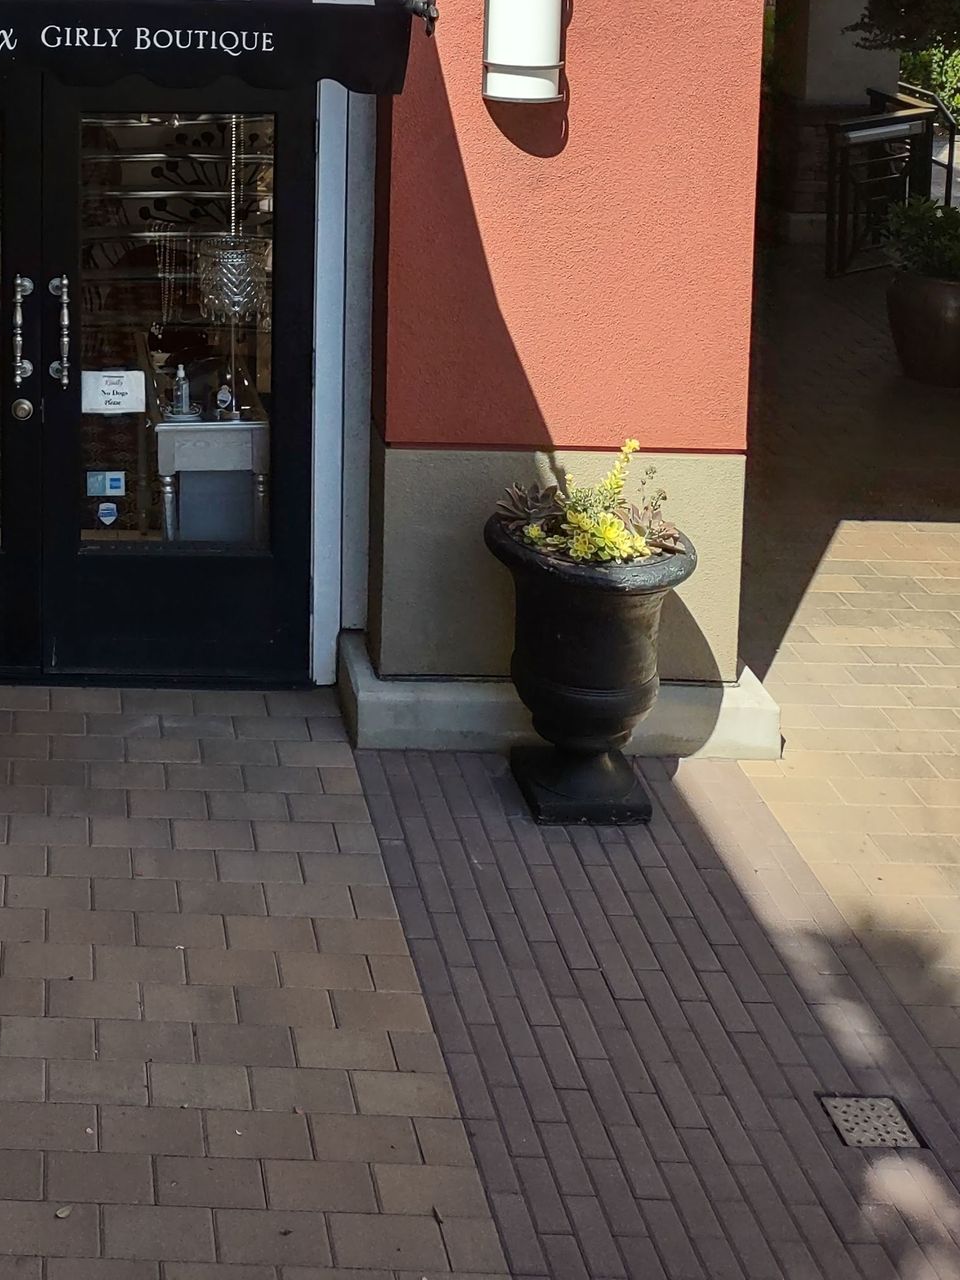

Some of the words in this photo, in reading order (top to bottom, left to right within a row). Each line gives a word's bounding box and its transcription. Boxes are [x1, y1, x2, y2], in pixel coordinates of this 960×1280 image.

[40, 24, 123, 48] GIRLY
[134, 26, 276, 57] BOUTIQUE
[112, 389, 129, 397] Dogs
